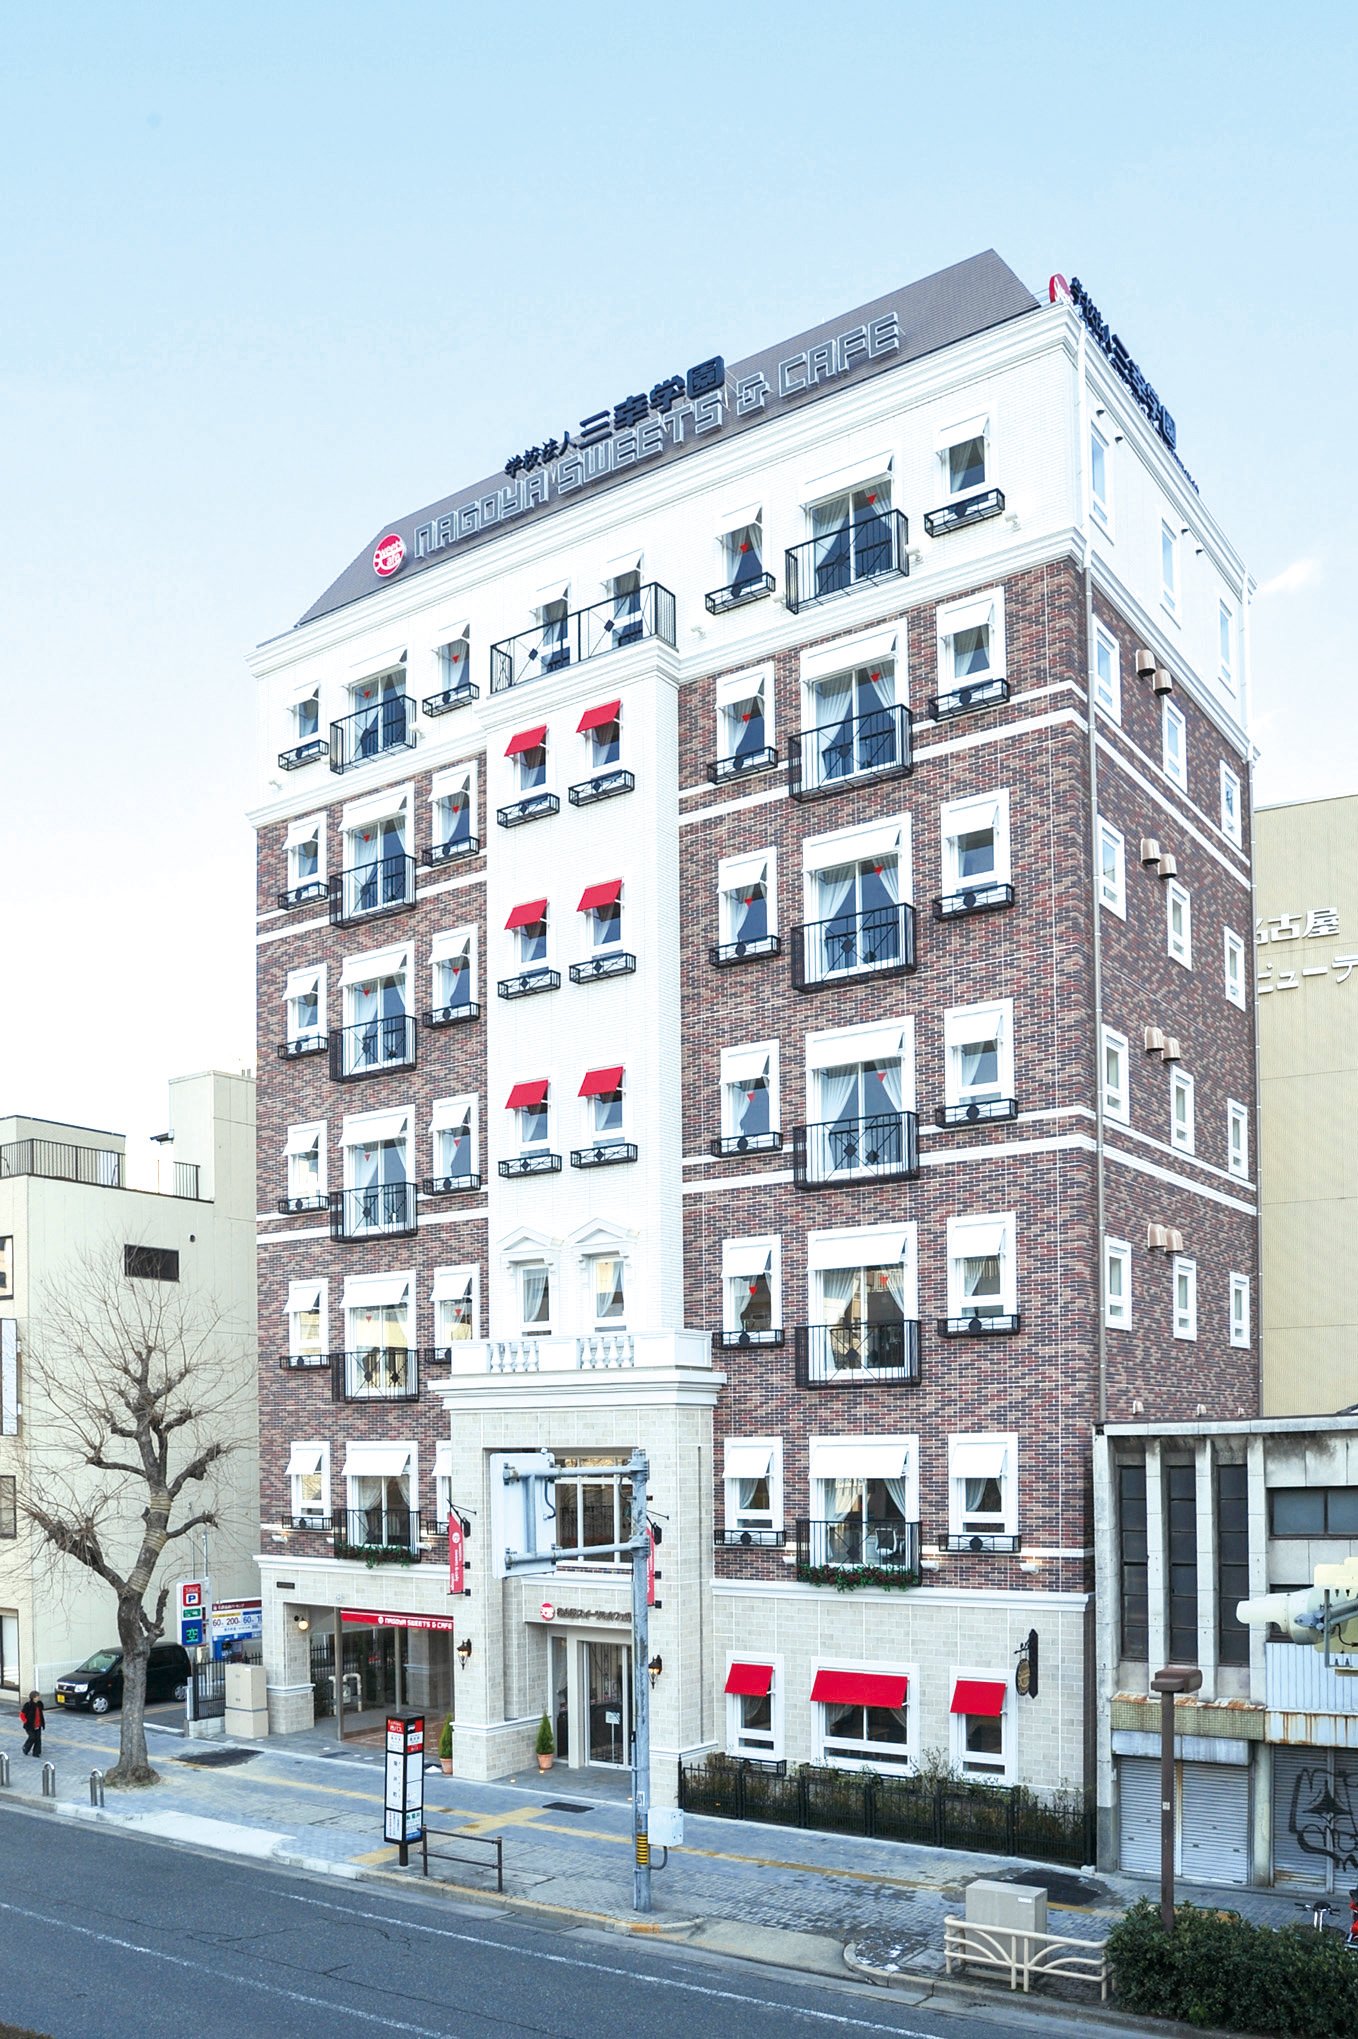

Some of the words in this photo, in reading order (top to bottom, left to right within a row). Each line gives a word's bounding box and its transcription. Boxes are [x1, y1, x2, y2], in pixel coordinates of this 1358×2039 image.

[414, 469, 550, 559] NAGOYA
[557, 388, 723, 495] SWEETS
[736, 371, 771, 416] &
[778, 312, 900, 398] CAFE
[437, 1622, 452, 1630] CAFE
